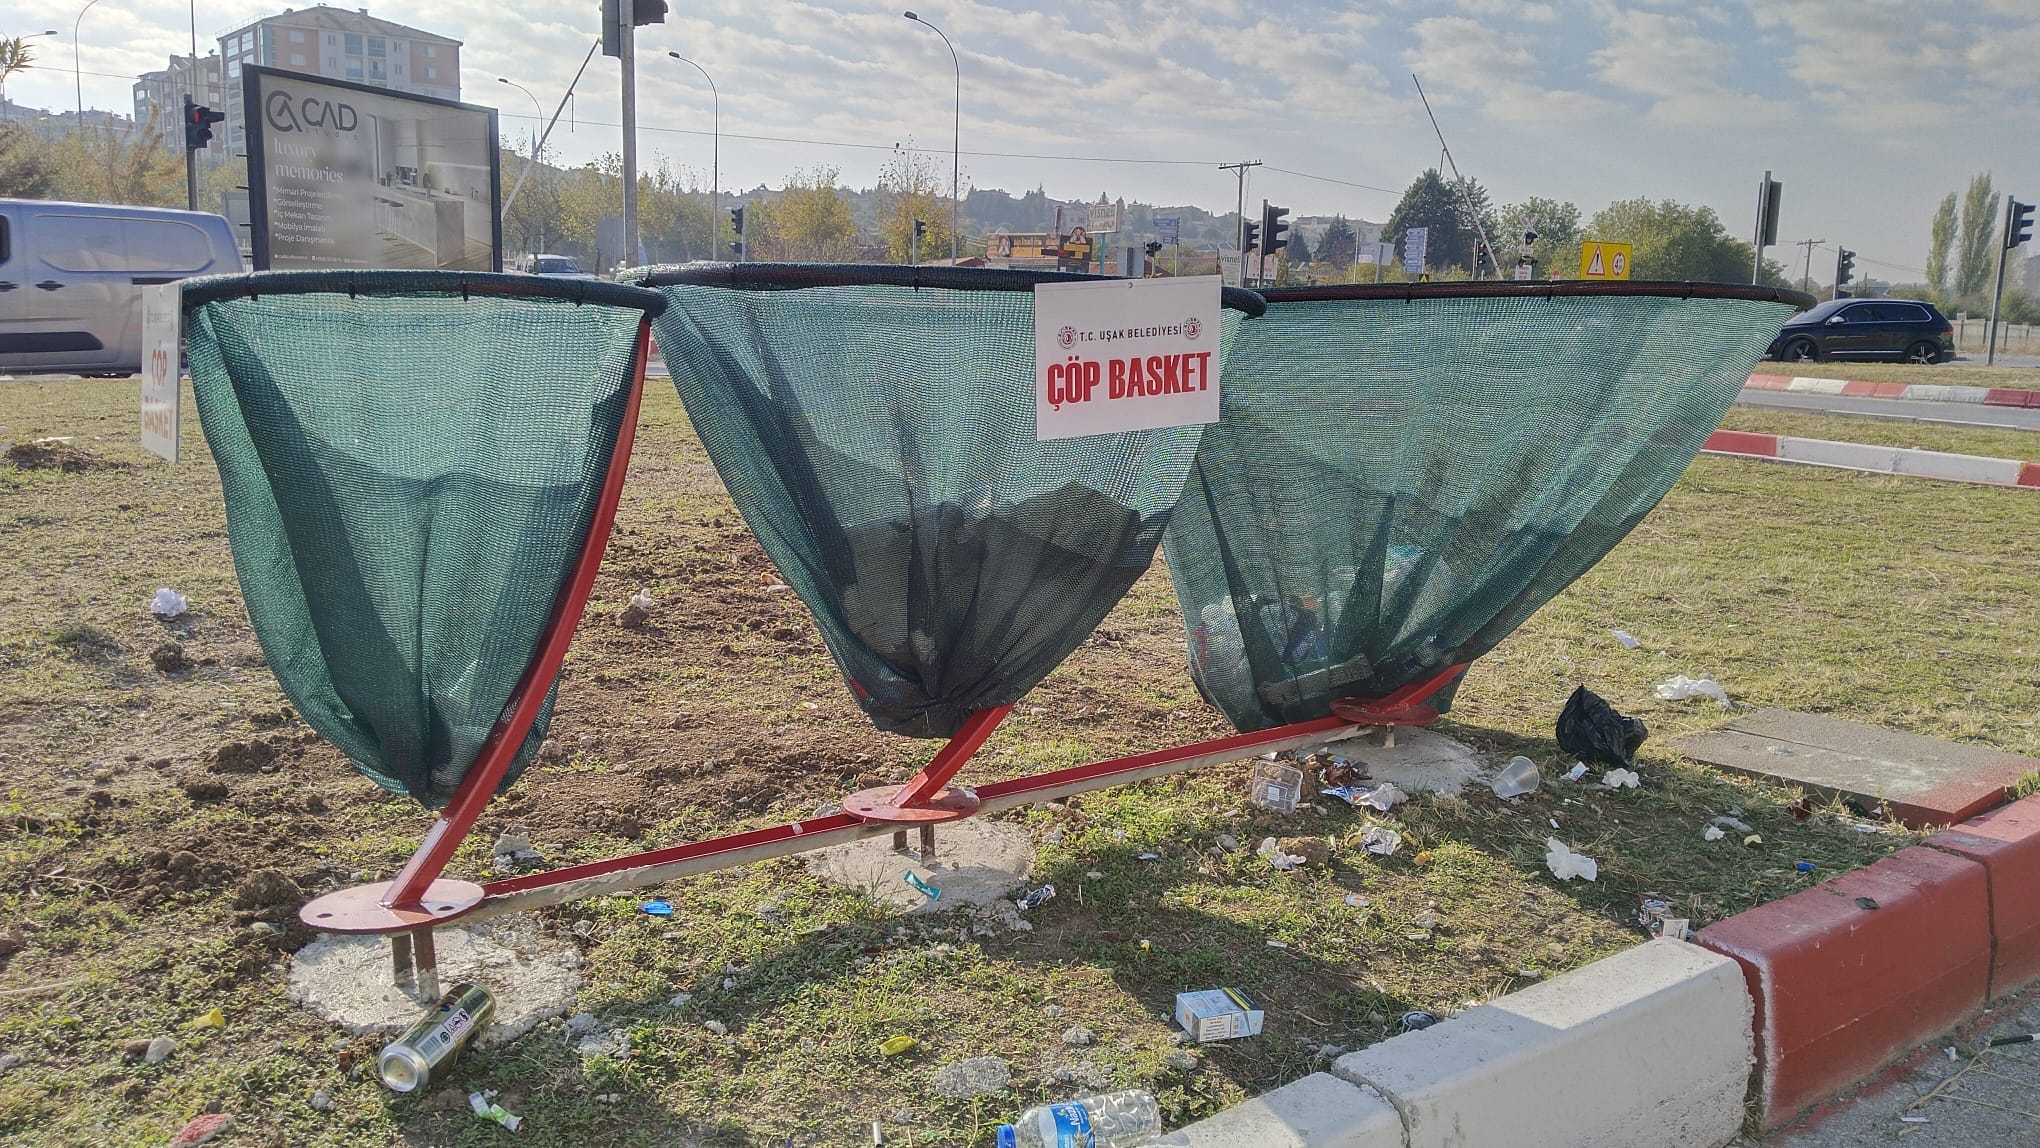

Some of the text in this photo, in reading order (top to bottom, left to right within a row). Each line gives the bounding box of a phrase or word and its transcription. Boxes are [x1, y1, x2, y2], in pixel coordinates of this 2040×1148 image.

[301, 97, 358, 132] CAD
[273, 136, 317, 162] luxury
[275, 163, 344, 184] memories
[278, 221, 303, 232] Mobilya
[278, 233, 295, 243] Proje
[1079, 322, 1183, 343] T.C. UŞAK BELEDİYESİ
[1047, 352, 1211, 411] ÇÖP BASKET
